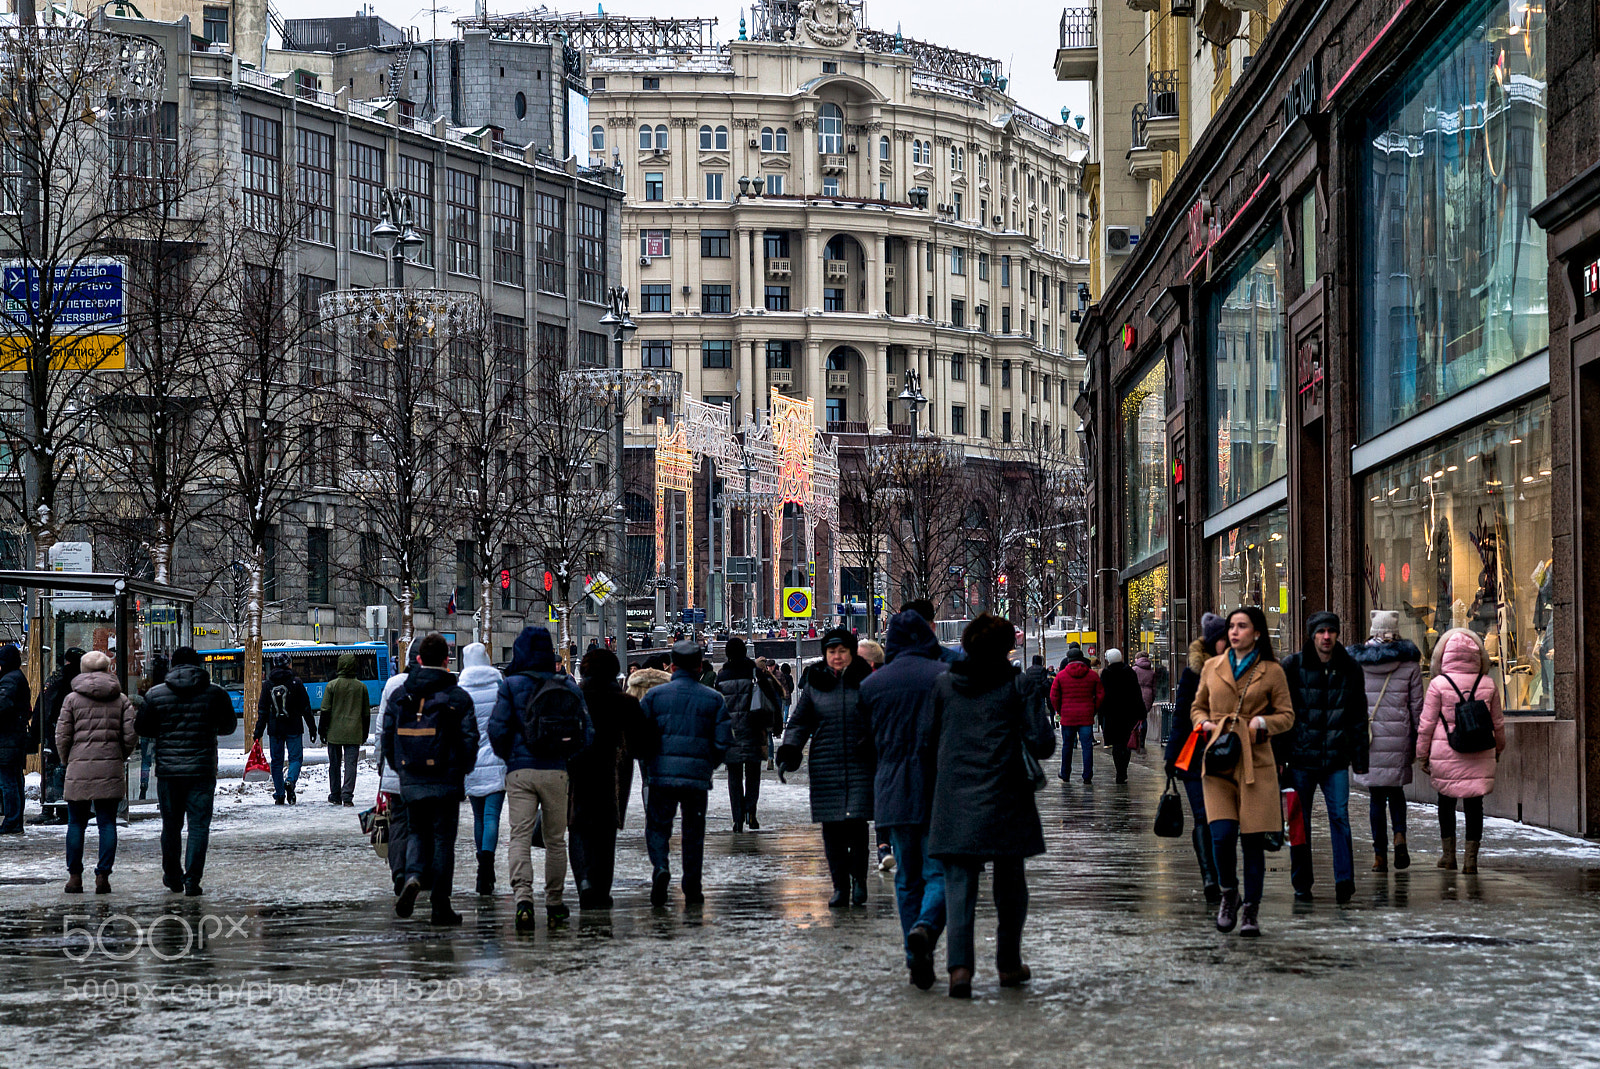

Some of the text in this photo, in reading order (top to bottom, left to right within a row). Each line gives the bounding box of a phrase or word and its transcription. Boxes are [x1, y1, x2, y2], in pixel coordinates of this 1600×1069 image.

[32, 268, 107, 278] ШЕМЕТЬЕВО
[32, 281, 112, 291] SREMETYEVO
[6, 301, 28, 310] E10
[6, 314, 25, 323] 10
[52, 313, 113, 323] ETERSBURG
